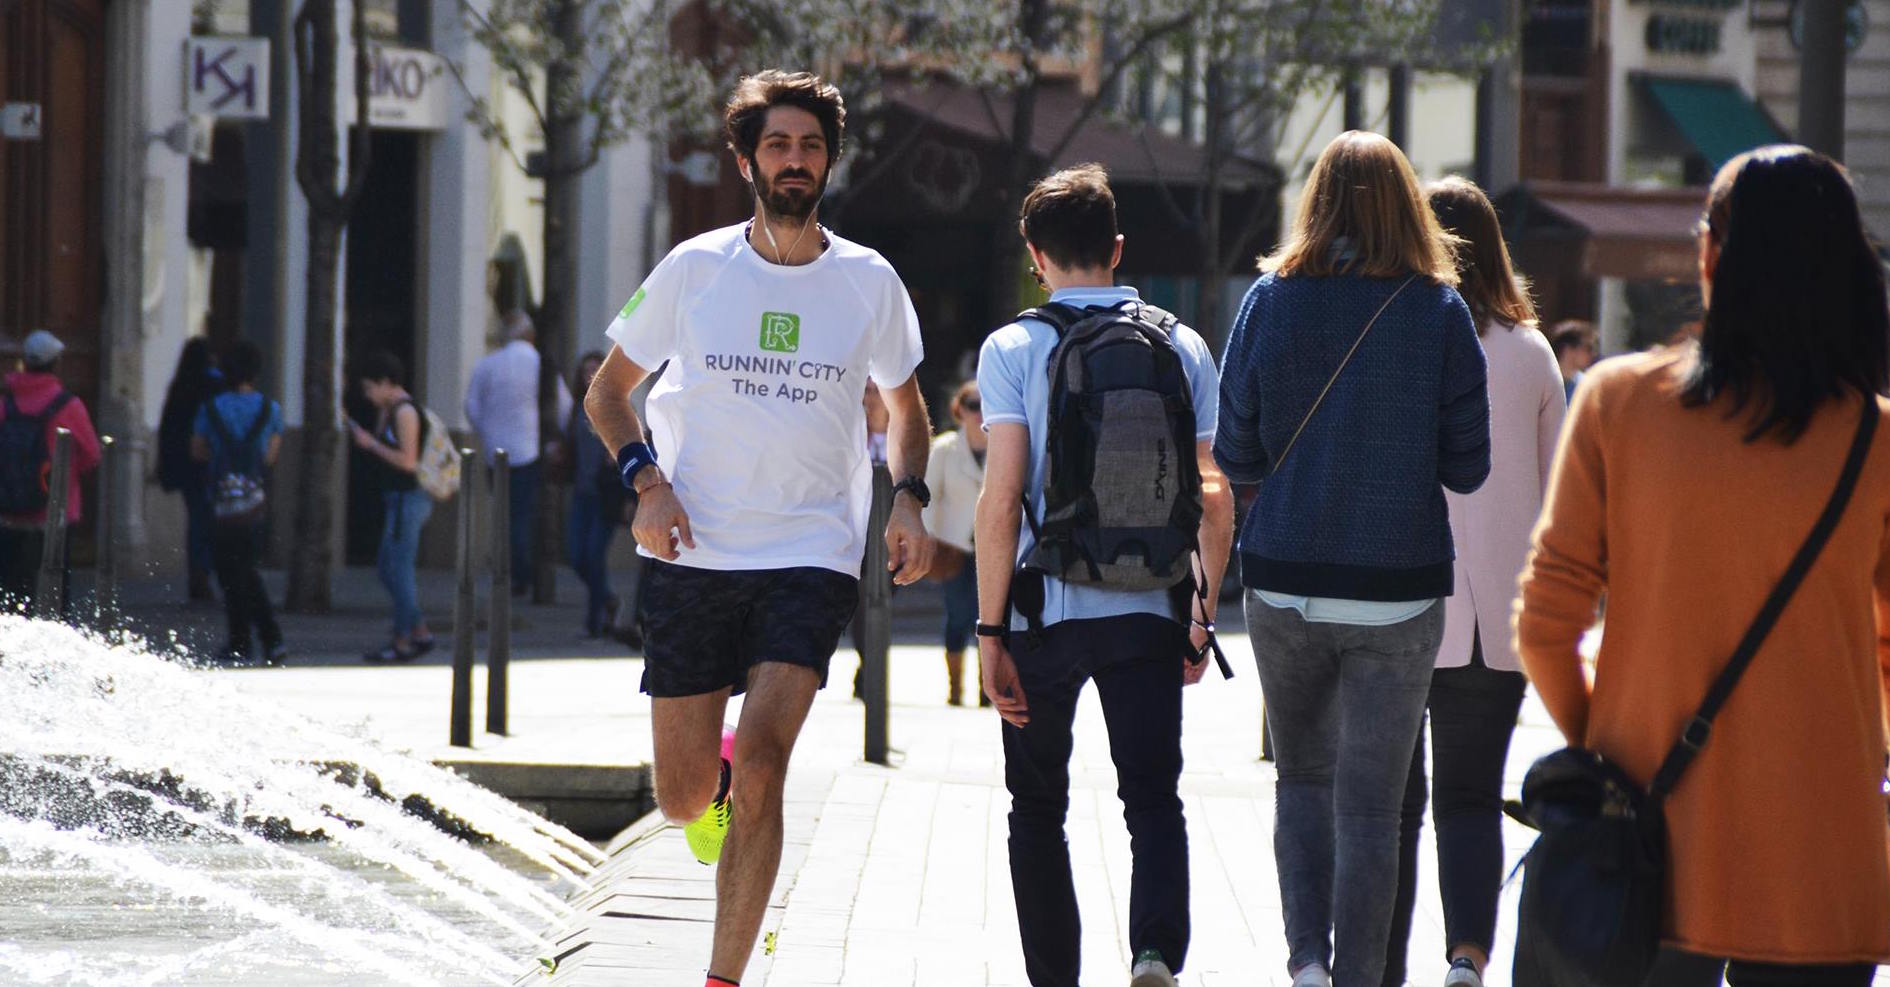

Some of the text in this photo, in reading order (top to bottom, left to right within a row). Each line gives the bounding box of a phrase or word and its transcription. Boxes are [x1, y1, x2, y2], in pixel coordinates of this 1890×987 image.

[705, 354, 846, 382] RUNNIN' CITY
[732, 378, 818, 404] The App
